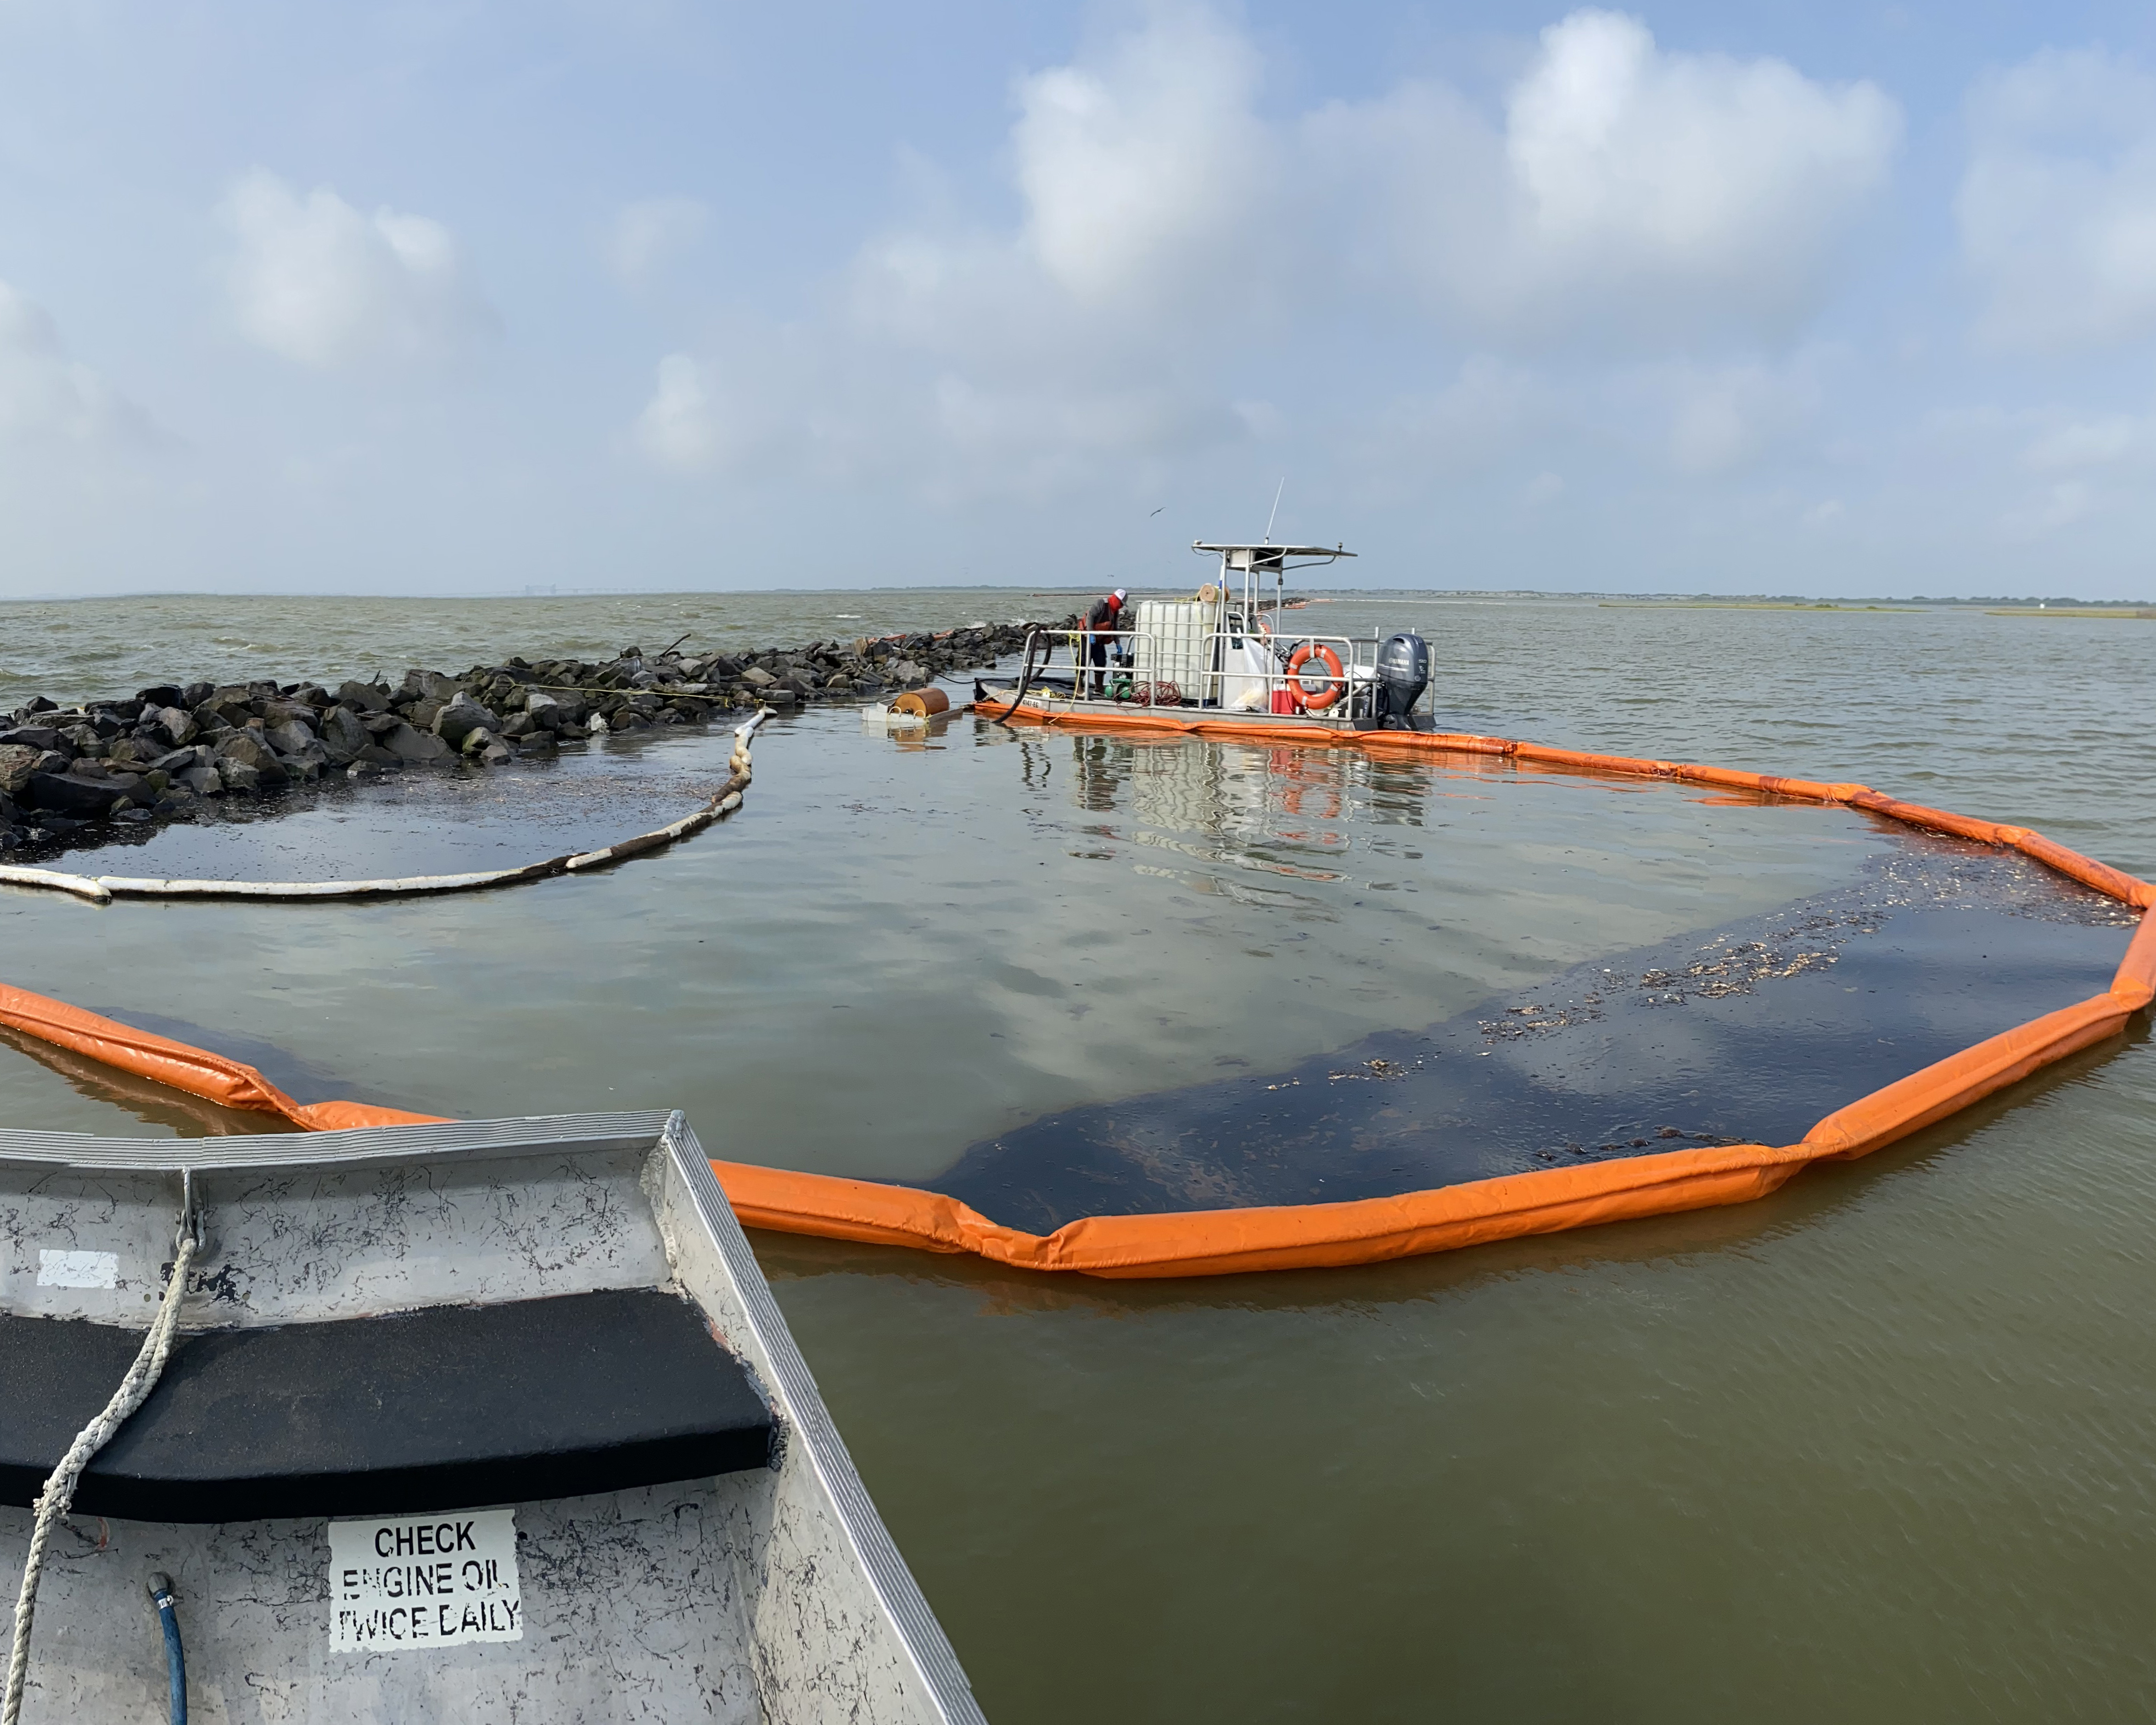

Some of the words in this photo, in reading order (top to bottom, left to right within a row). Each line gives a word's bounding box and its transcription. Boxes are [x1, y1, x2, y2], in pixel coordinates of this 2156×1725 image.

[375, 1521, 476, 1557] CHECK
[343, 1563, 454, 1600] ENGINE
[462, 1560, 510, 1591] OIL
[339, 1607, 429, 1641] TWICE
[439, 1599, 520, 1636] DAILY
